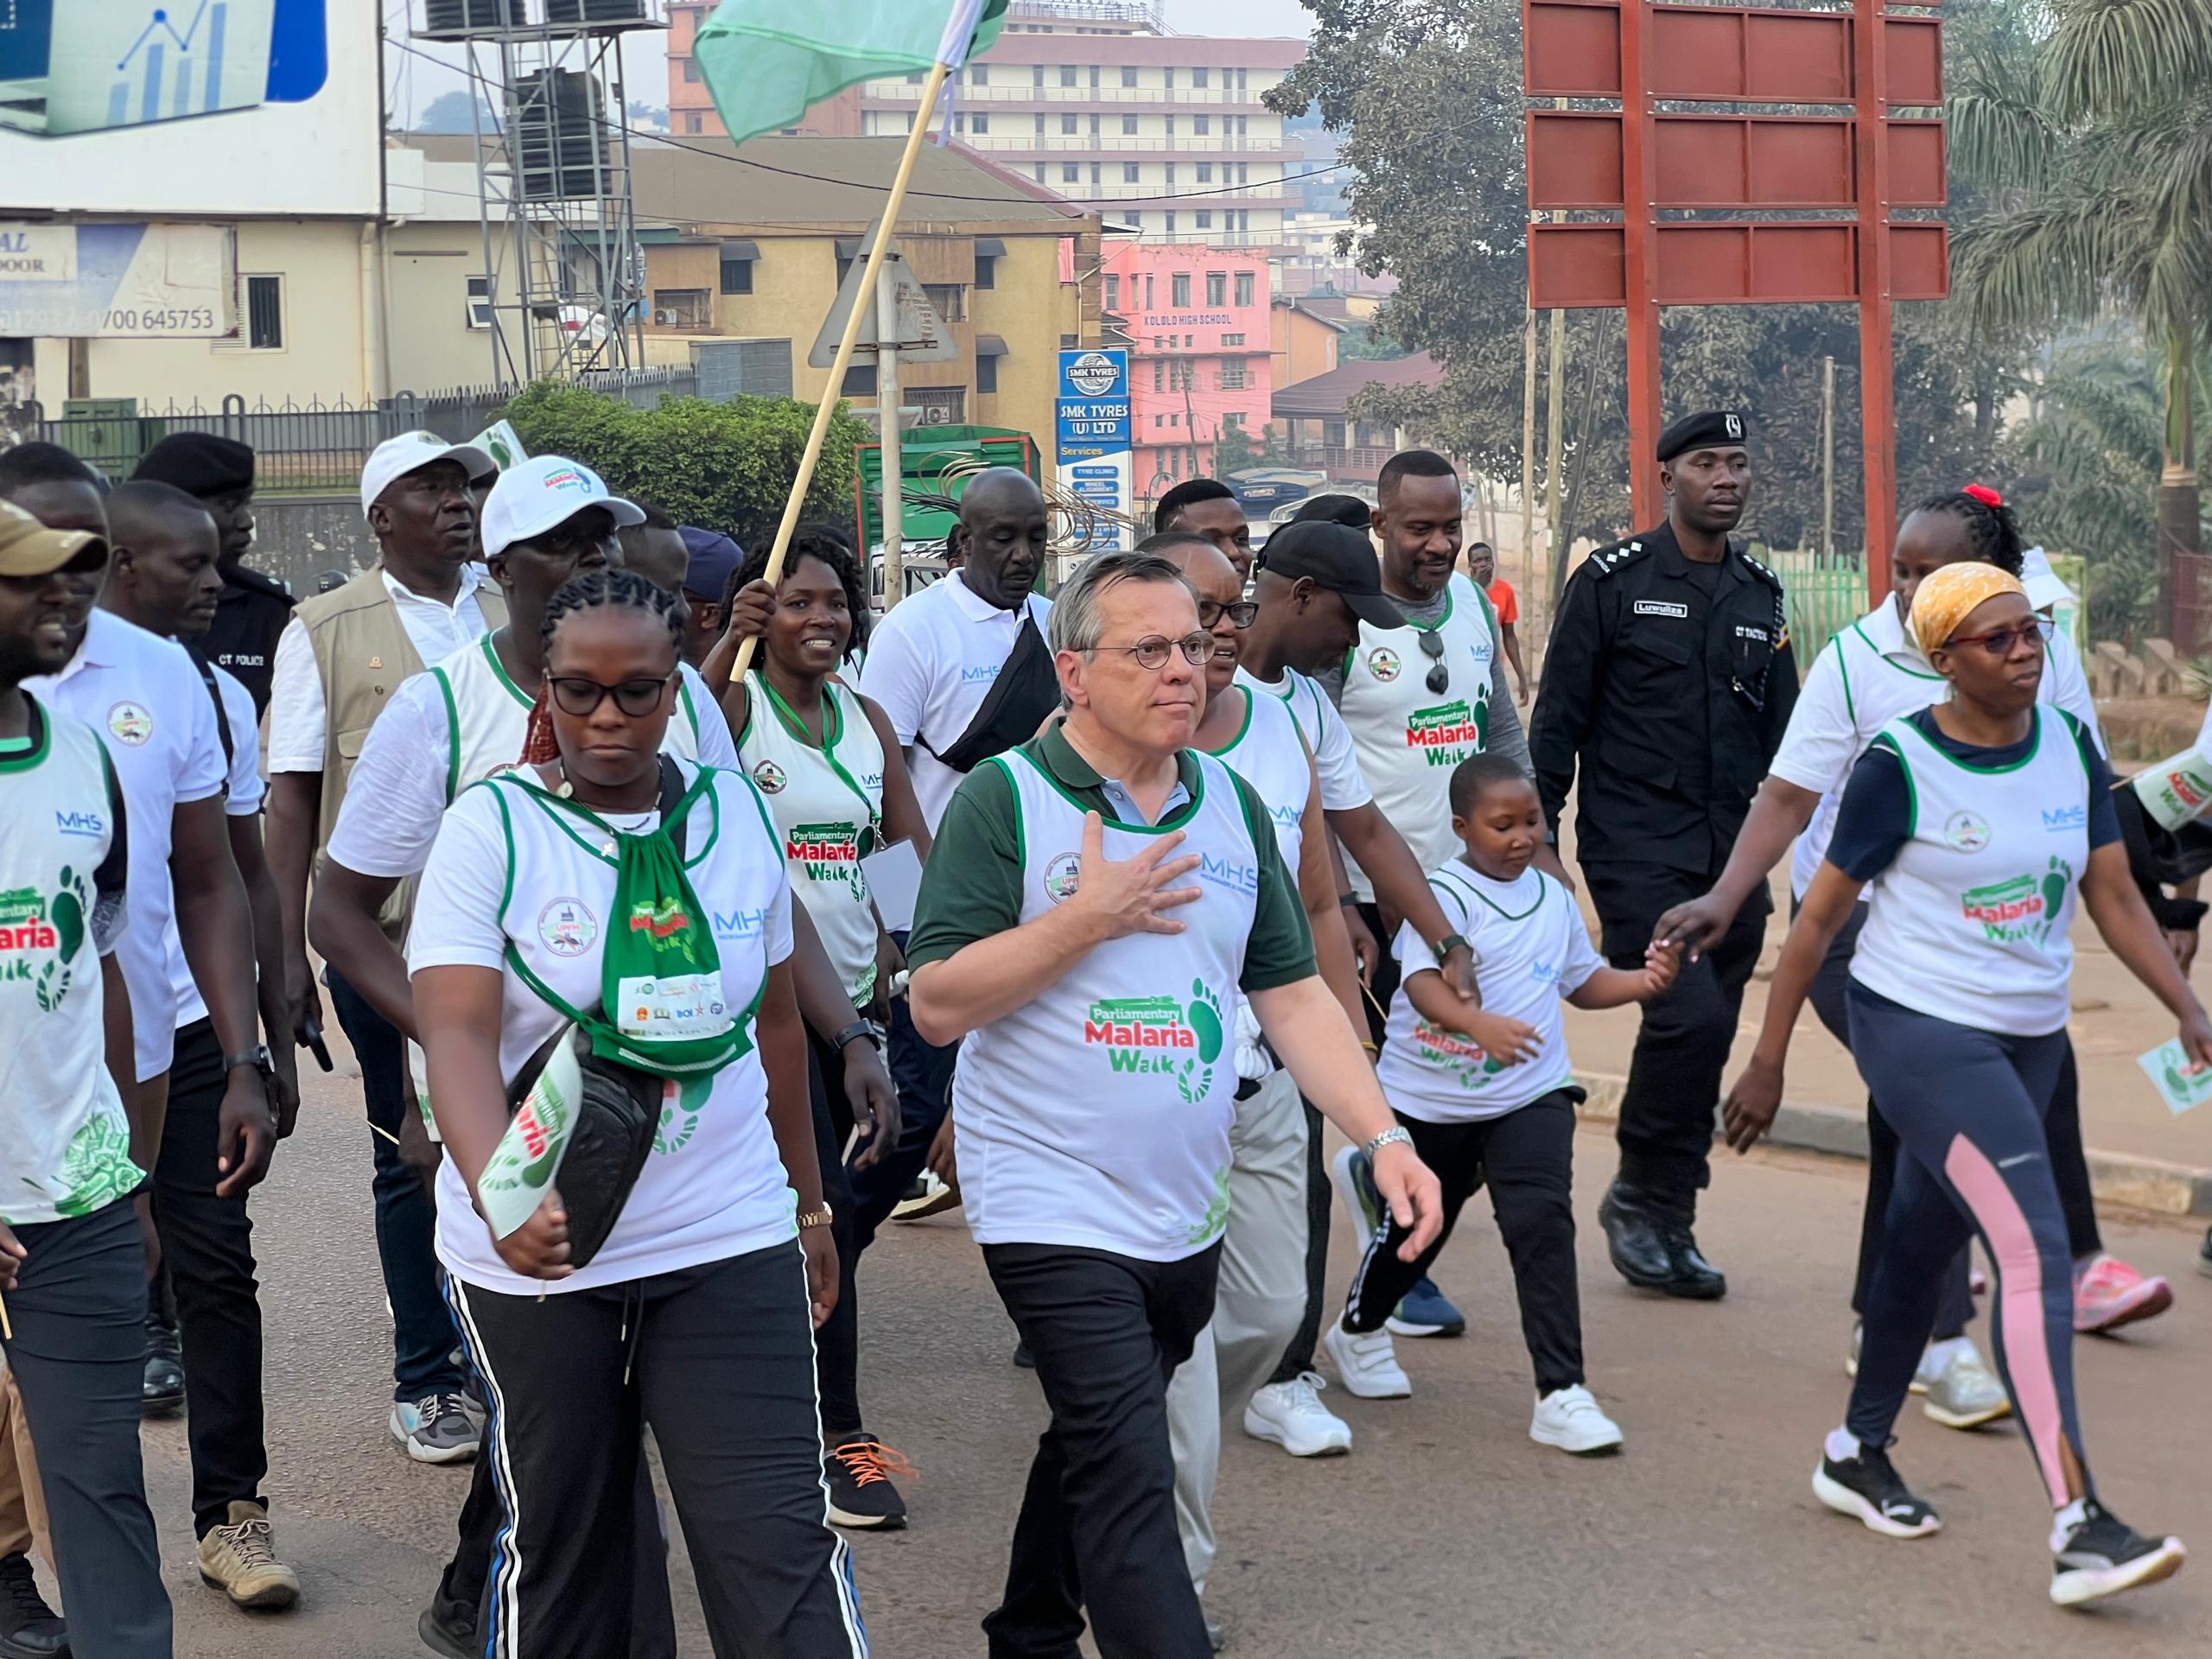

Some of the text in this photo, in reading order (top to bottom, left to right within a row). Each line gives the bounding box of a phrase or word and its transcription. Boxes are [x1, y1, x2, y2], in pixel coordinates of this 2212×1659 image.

[143, 309, 214, 329] 645753
[1144, 314, 1232, 326] KOLOLO HIGH SCHOOL
[1069, 367, 1116, 377] SMK TYRES
[1060, 404, 1128, 417] SMK TYRES
[1072, 422, 1116, 434] (U) LTD
[1061, 447, 1103, 455] Services
[219, 654, 264, 666] CT POLICE
[1411, 710, 1469, 728] Parliamentary
[1406, 719, 1476, 747] Malaria
[1424, 747, 1466, 766] Walk
[56, 810, 102, 831] MHS
[792, 831, 855, 841] Parliamentary
[787, 840, 856, 861] Malaria
[804, 862, 849, 880] Walk
[1202, 852, 1257, 889] MHS
[0, 903, 43, 918] entary
[1963, 895, 2042, 923] Malaria
[1093, 1007, 1179, 1020] Parliamentary
[1084, 1020, 1194, 1047] Malaria
[1108, 1048, 1175, 1074] Walk
